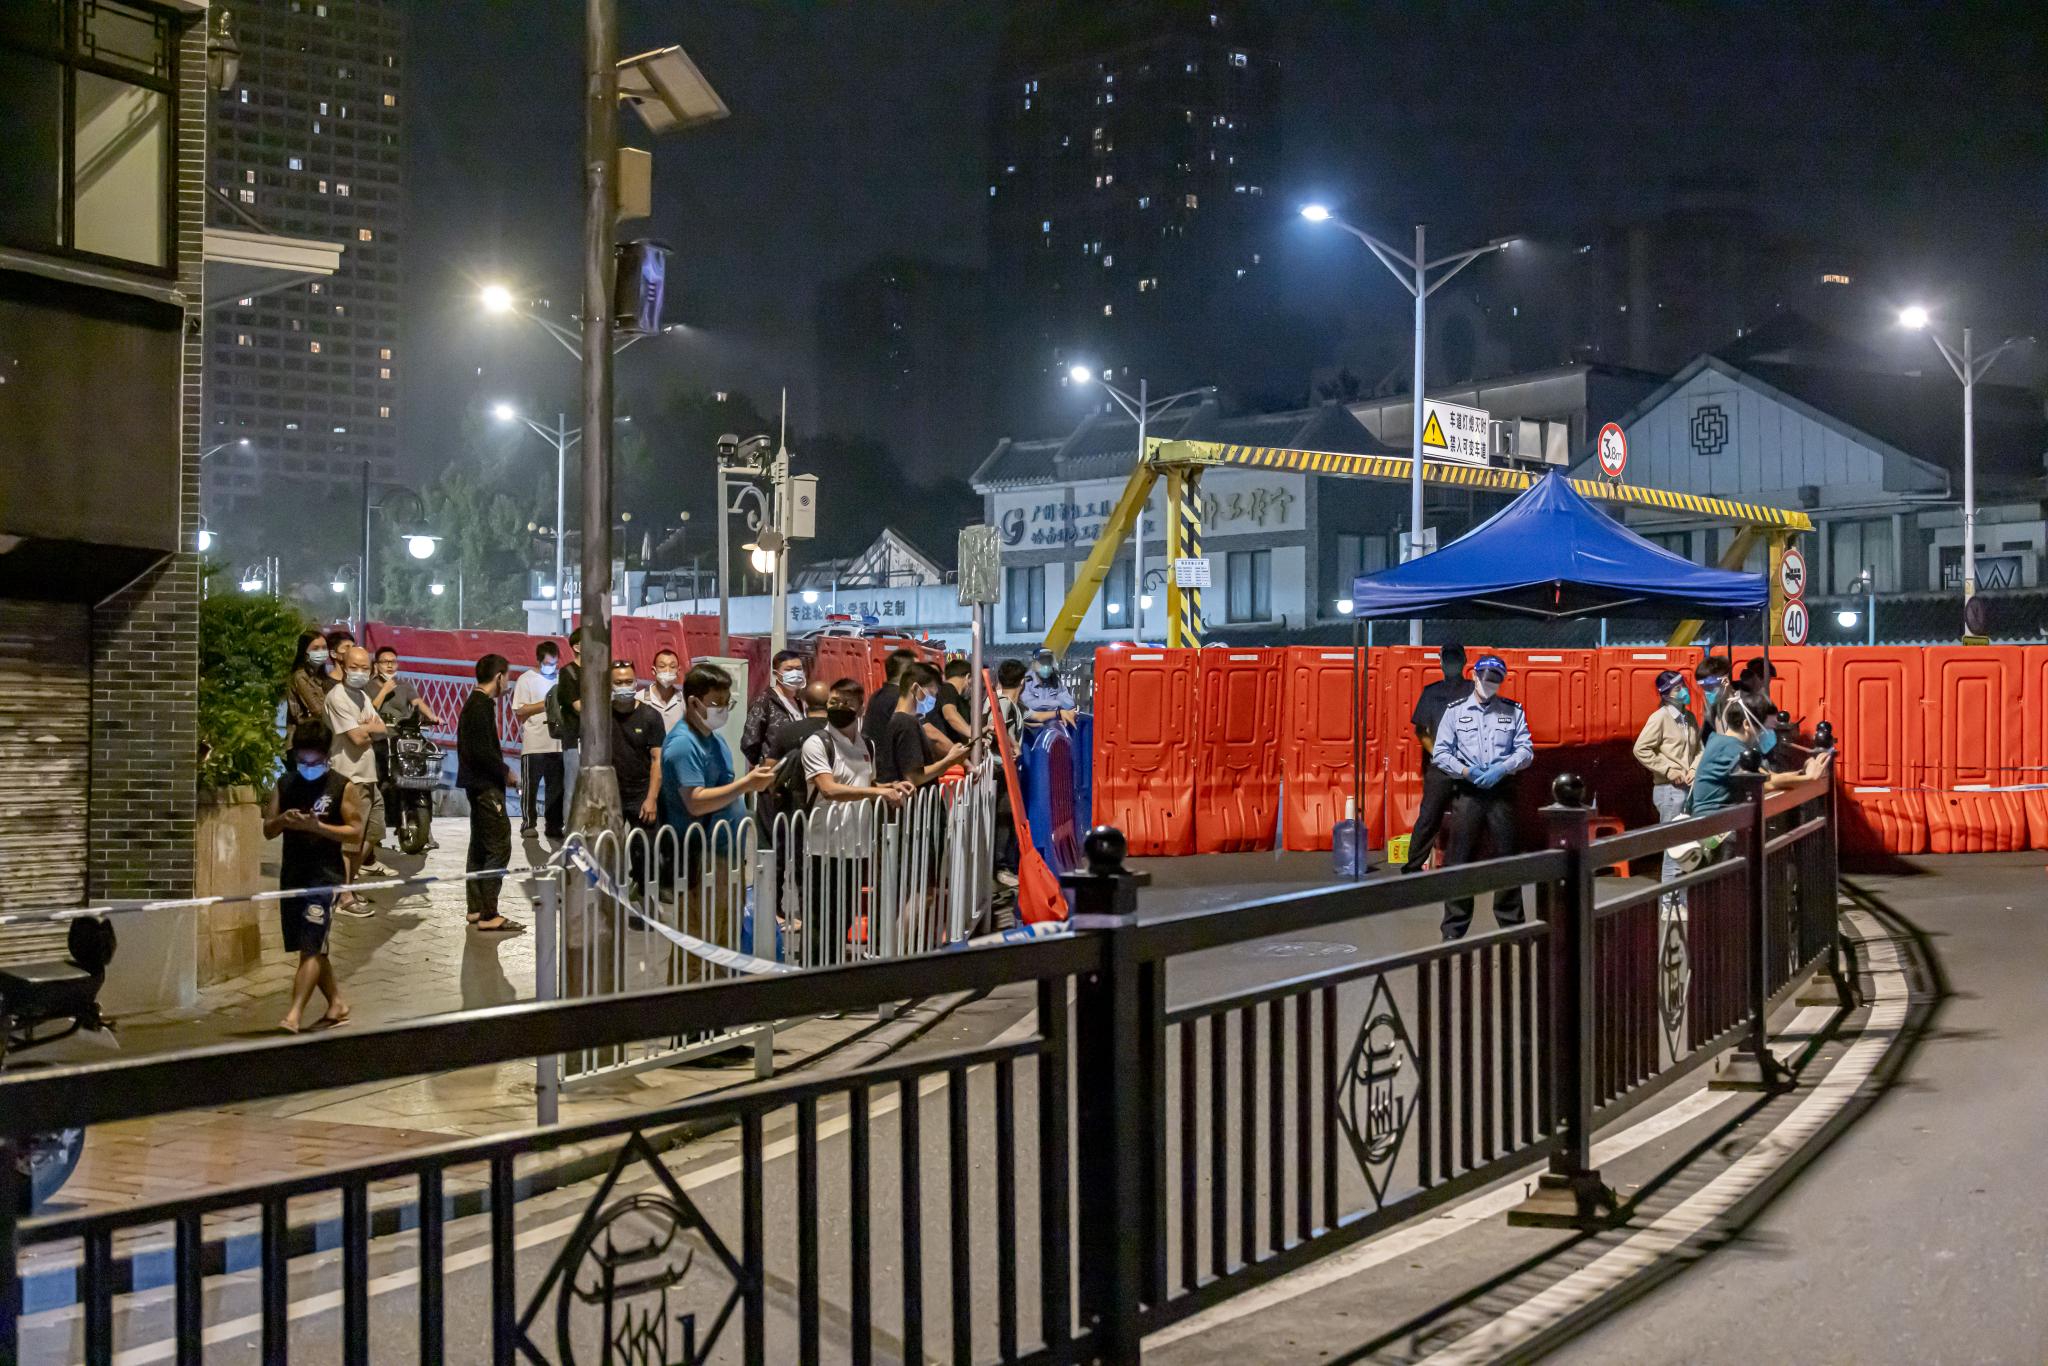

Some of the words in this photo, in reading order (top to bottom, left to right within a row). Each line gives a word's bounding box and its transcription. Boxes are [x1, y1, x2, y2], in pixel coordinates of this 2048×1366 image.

[1450, 411, 1487, 435] 车道灯熄灭时
[1787, 610, 1802, 638] 40
